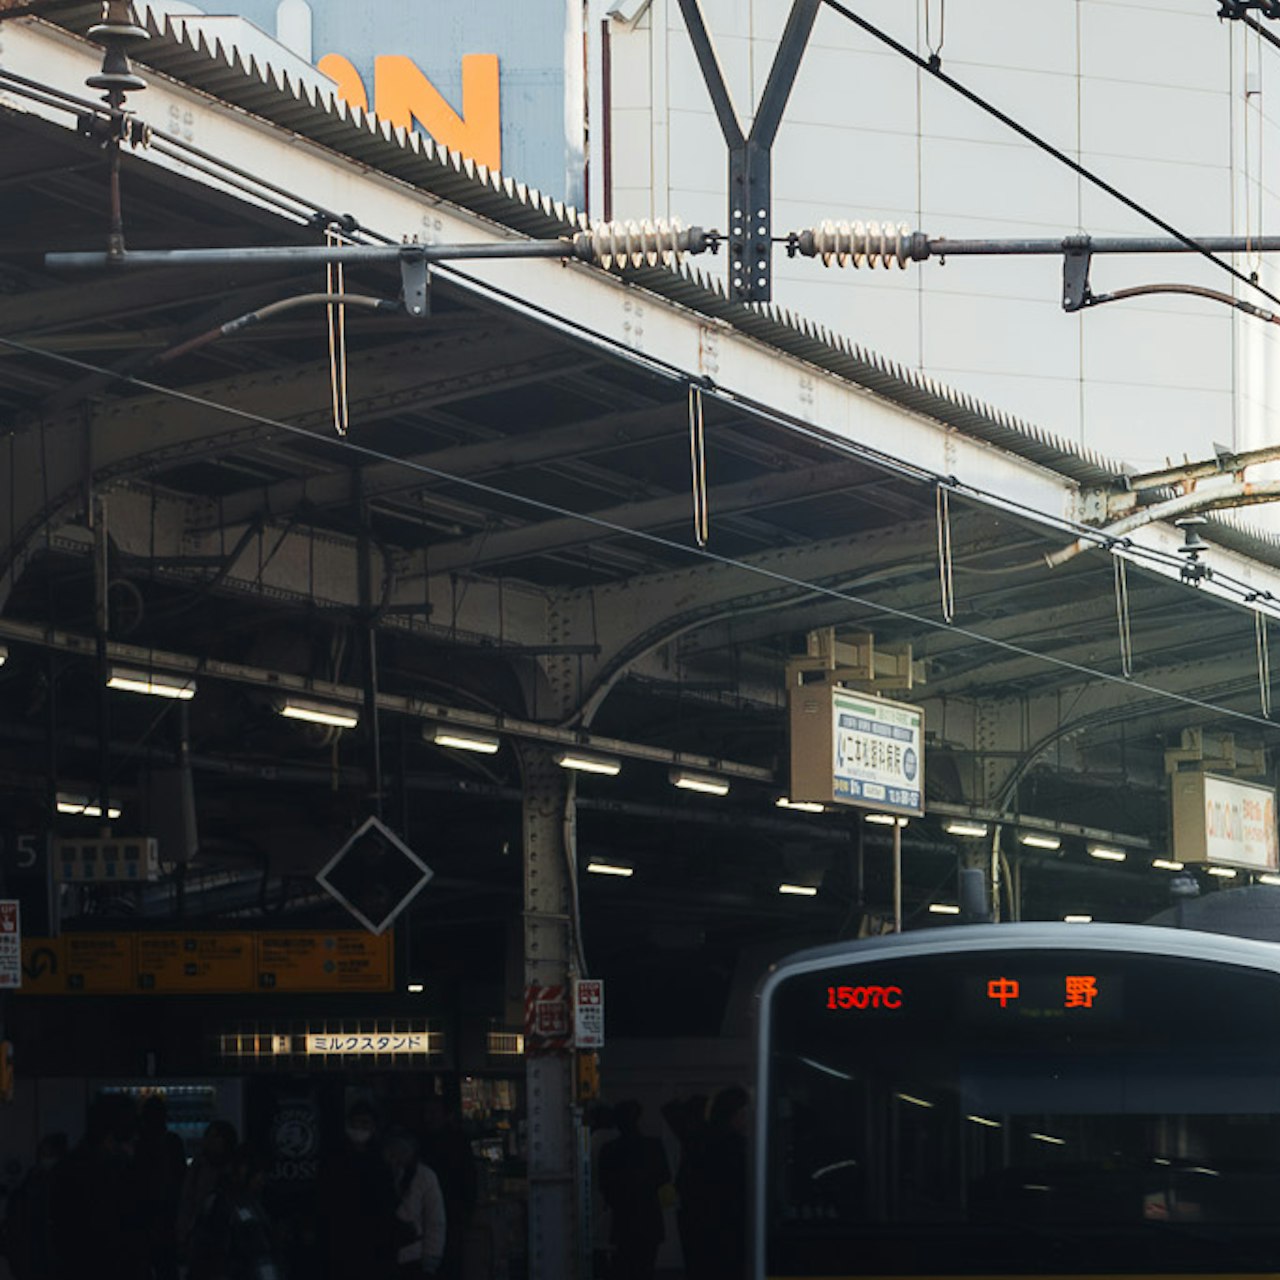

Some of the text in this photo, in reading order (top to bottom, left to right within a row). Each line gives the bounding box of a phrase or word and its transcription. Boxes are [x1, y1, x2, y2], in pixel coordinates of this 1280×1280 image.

[17, 835, 37, 868] 5
[827, 986, 903, 1009] 1507C
[314, 1036, 421, 1050] ミルクスタンド
